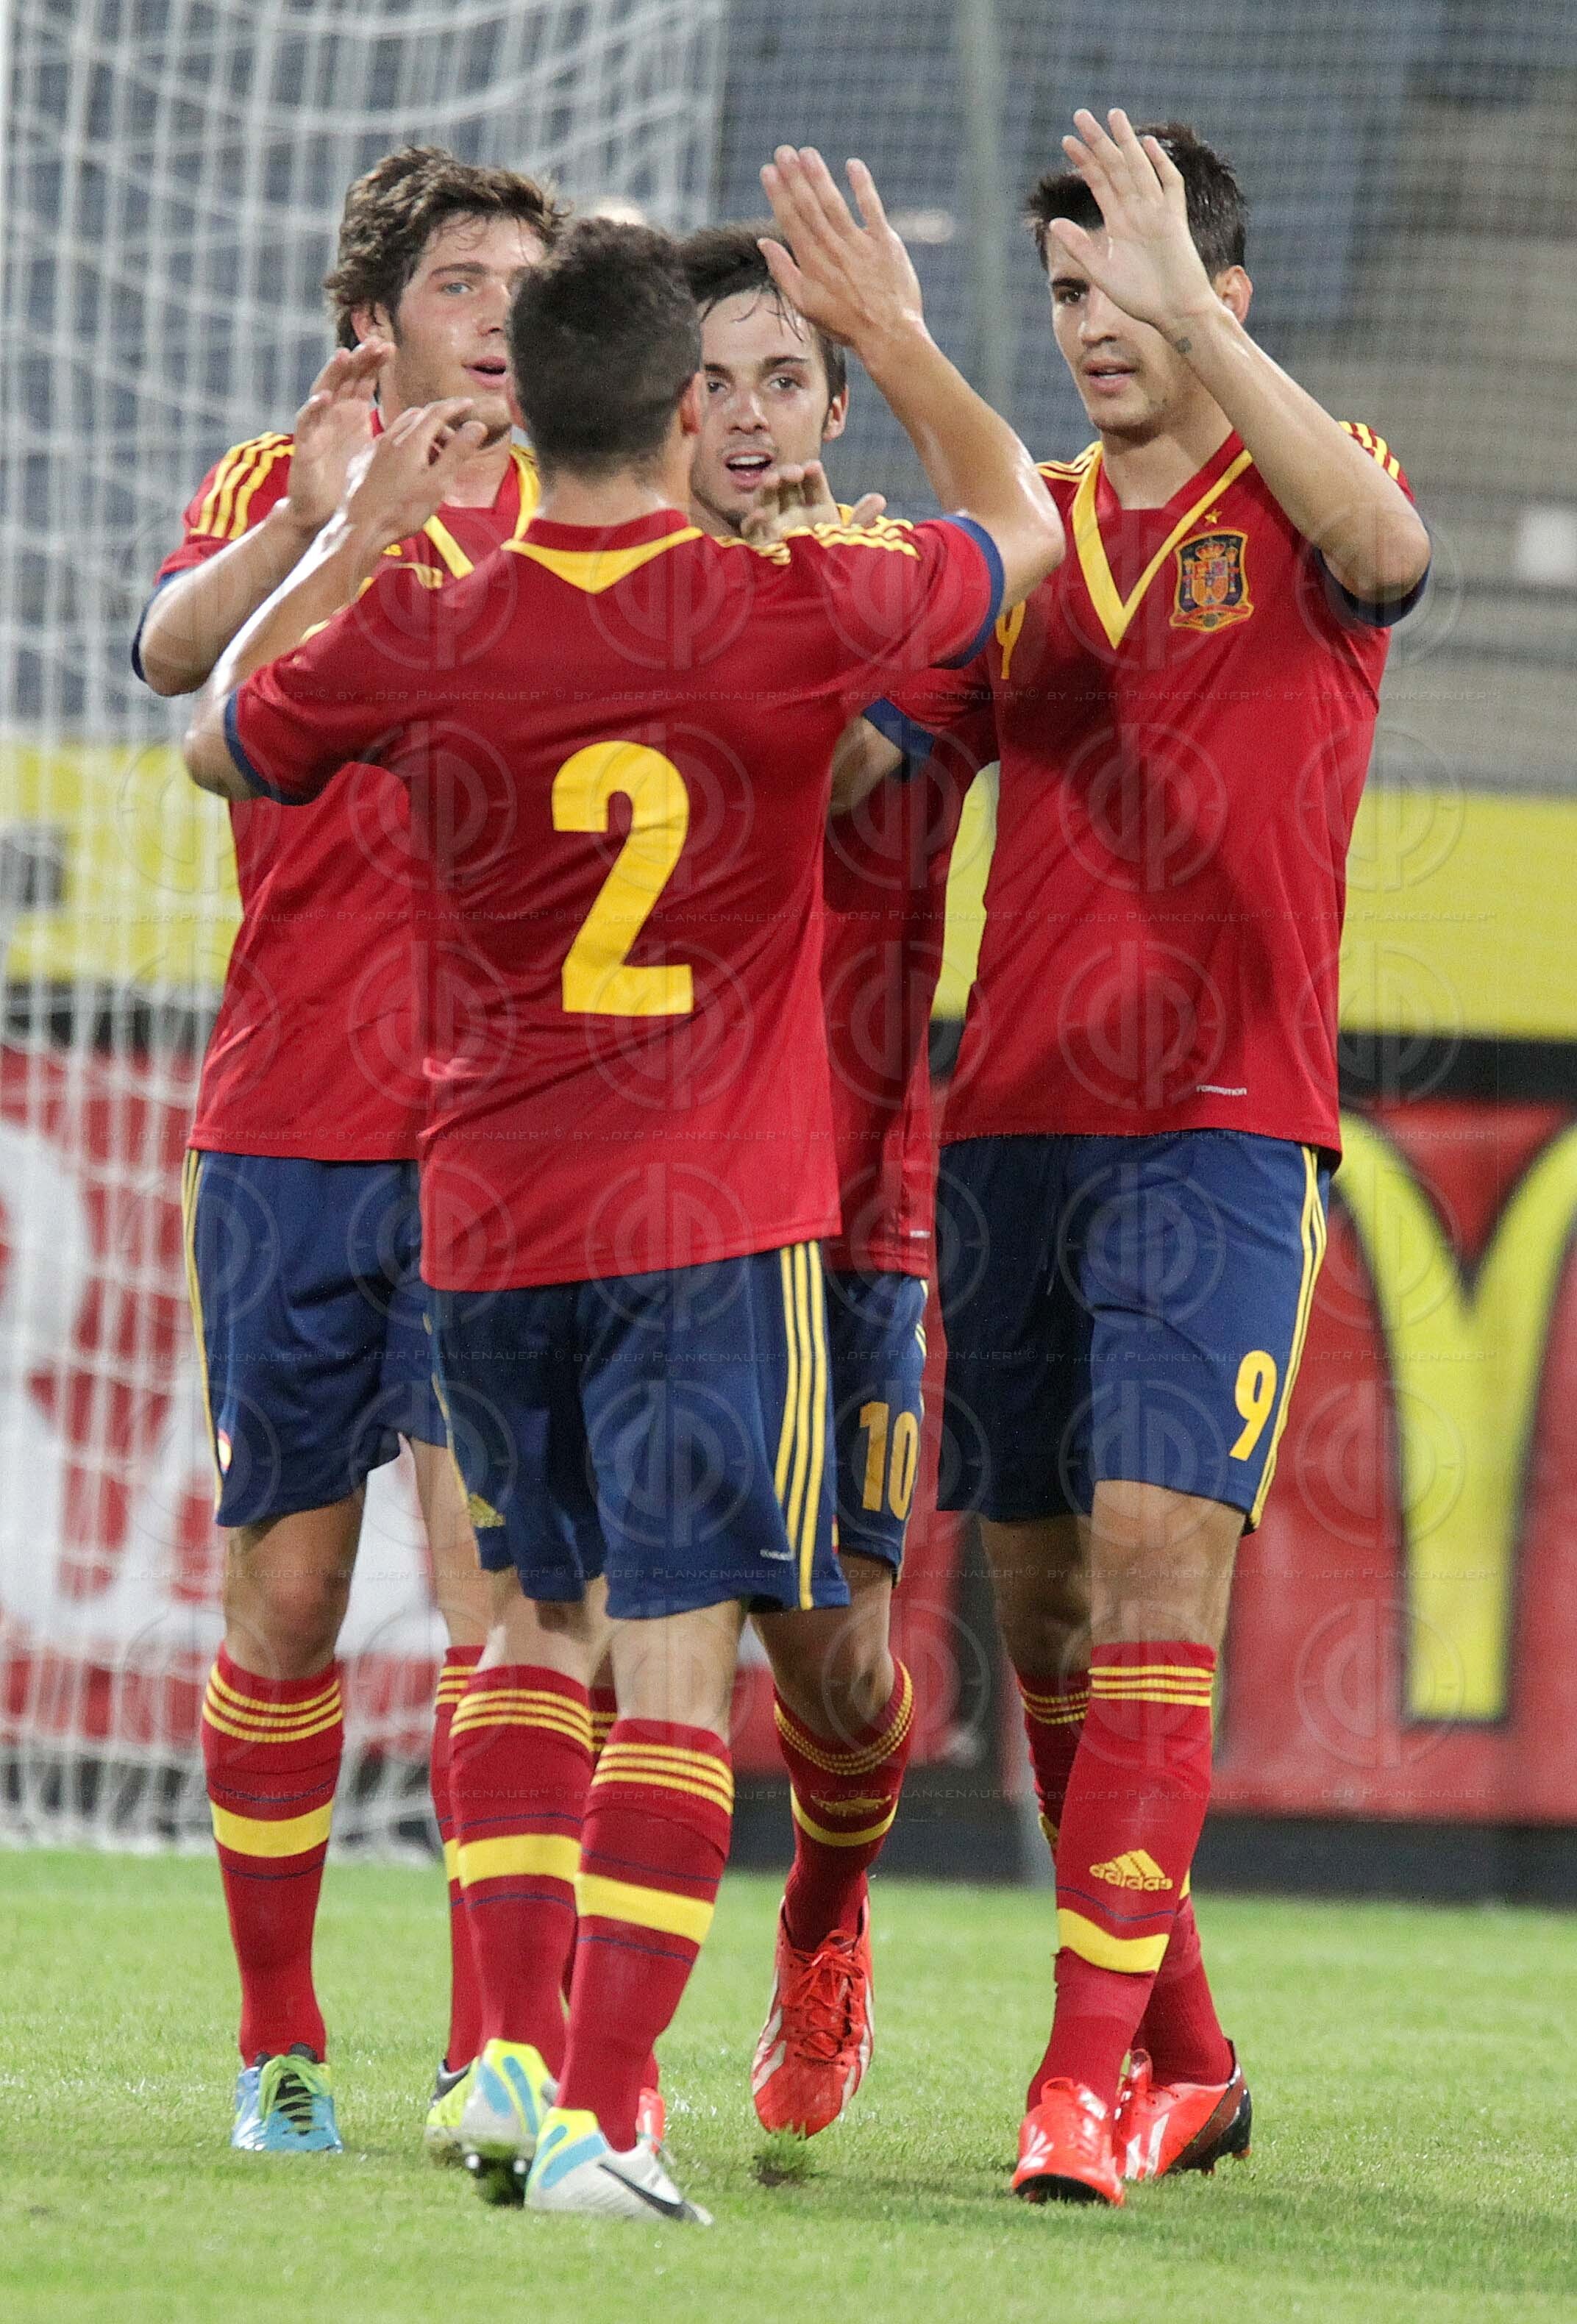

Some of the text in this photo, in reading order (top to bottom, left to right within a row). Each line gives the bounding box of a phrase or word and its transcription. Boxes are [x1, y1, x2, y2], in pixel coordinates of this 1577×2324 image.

[552, 740, 694, 1016] 2
[859, 1401, 919, 1521] 10
[1229, 1350, 1278, 1461] 9
[1089, 1862, 1173, 1892] adidas
